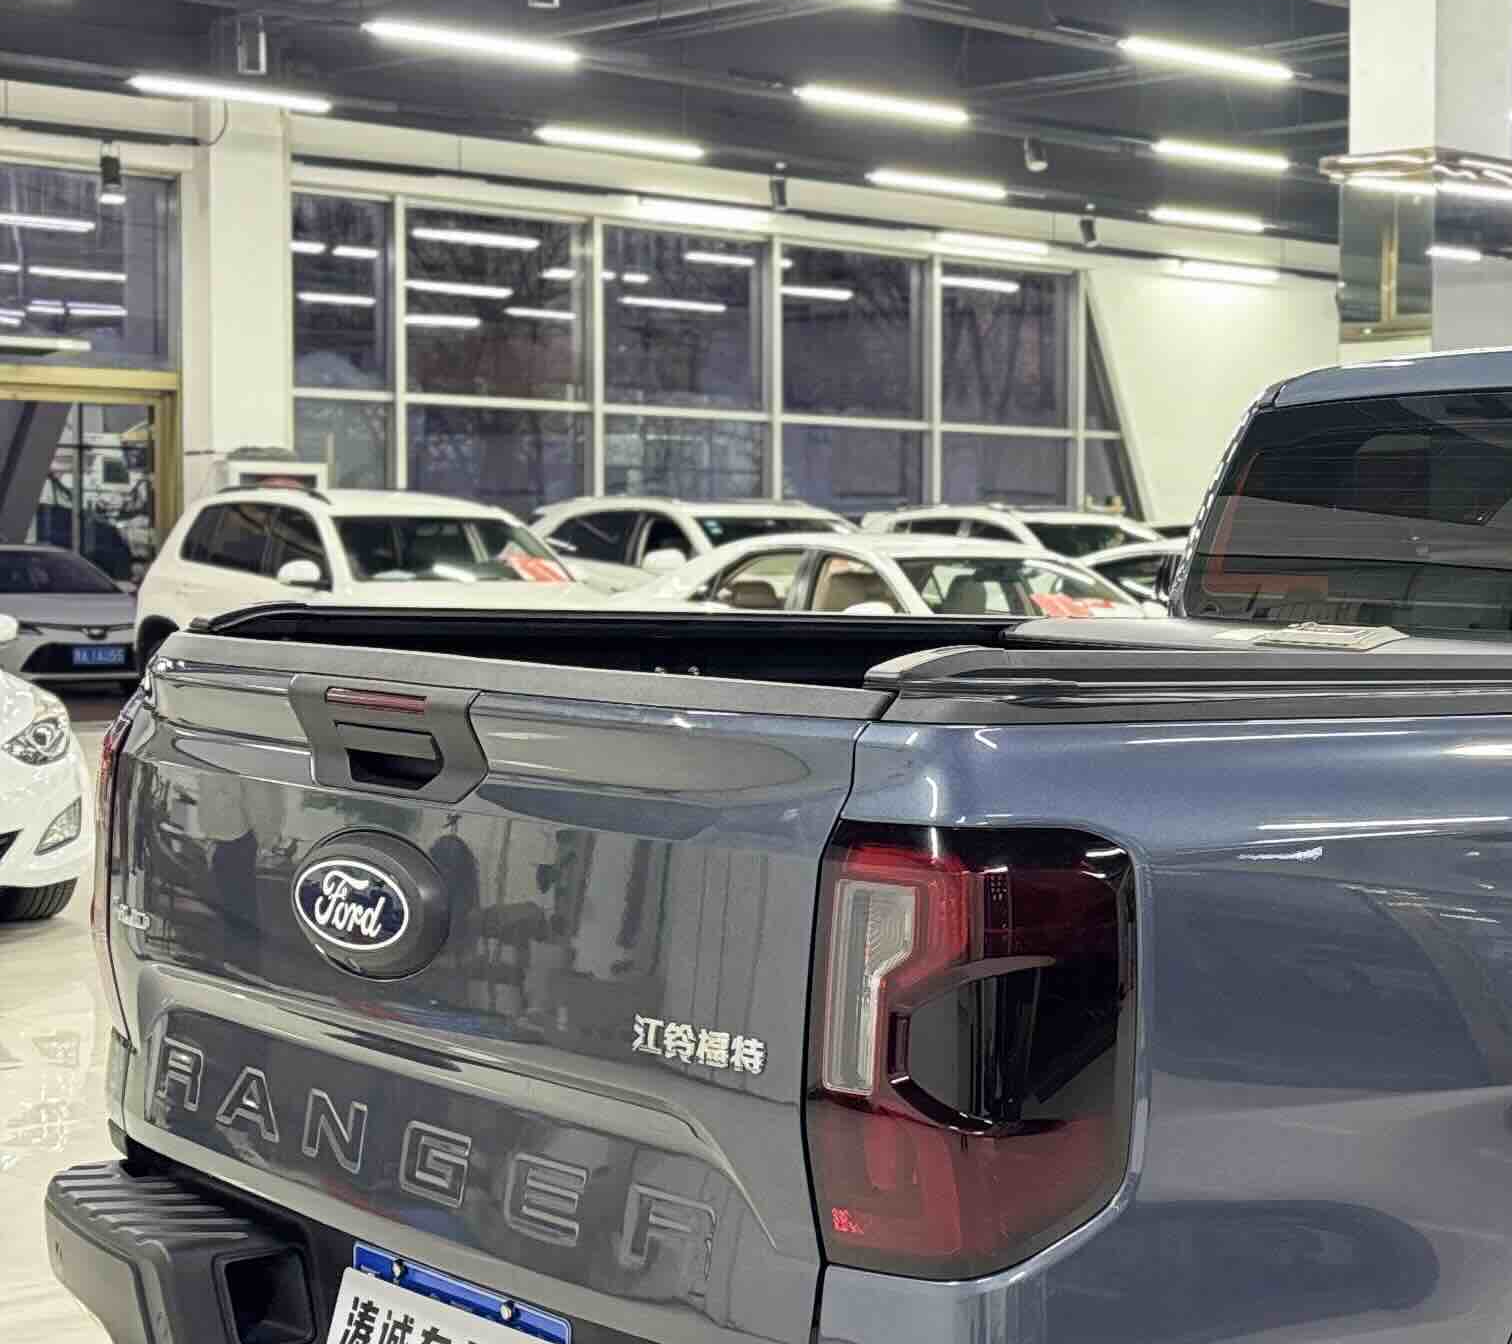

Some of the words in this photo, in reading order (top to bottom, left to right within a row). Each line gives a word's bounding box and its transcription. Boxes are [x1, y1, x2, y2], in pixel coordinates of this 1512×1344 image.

[313, 869, 386, 938] Ford
[631, 1013, 768, 1075] 江铃福特
[148, 1033, 720, 1292] RANGER
